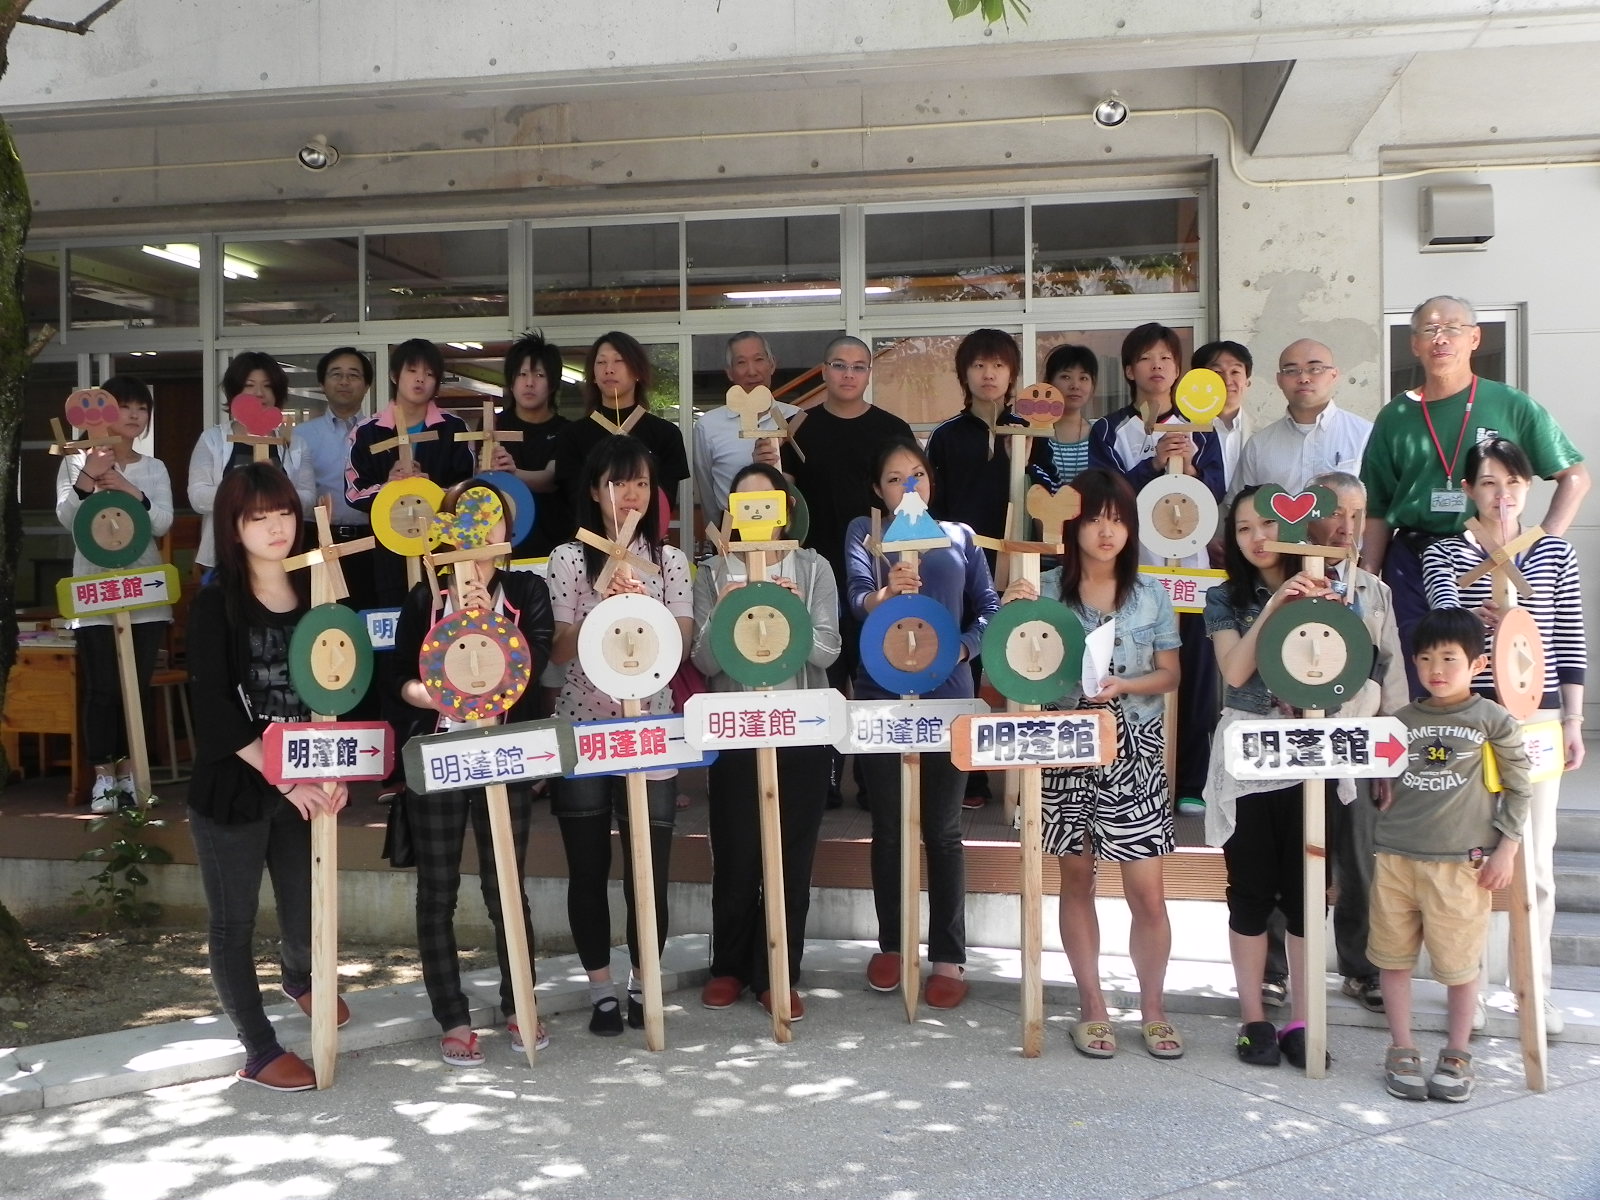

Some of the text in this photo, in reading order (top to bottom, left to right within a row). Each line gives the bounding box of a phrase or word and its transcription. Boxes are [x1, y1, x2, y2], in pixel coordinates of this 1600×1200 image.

[77, 576, 144, 605] 明蓬館
[372, 617, 399, 640] 明
[708, 708, 797, 739] 明蓬館
[857, 716, 943, 745] 明蓬館
[1407, 725, 1486, 745] OMETHING
[288, 737, 358, 769] 明蓬館
[578, 726, 668, 762] 明蓬館
[977, 719, 1095, 761] 明蓬館
[1242, 727, 1370, 769] 明蓬館
[1427, 746, 1446, 760] 34
[431, 746, 525, 784] 明蓬館
[1402, 771, 1468, 791] SPECIAL
